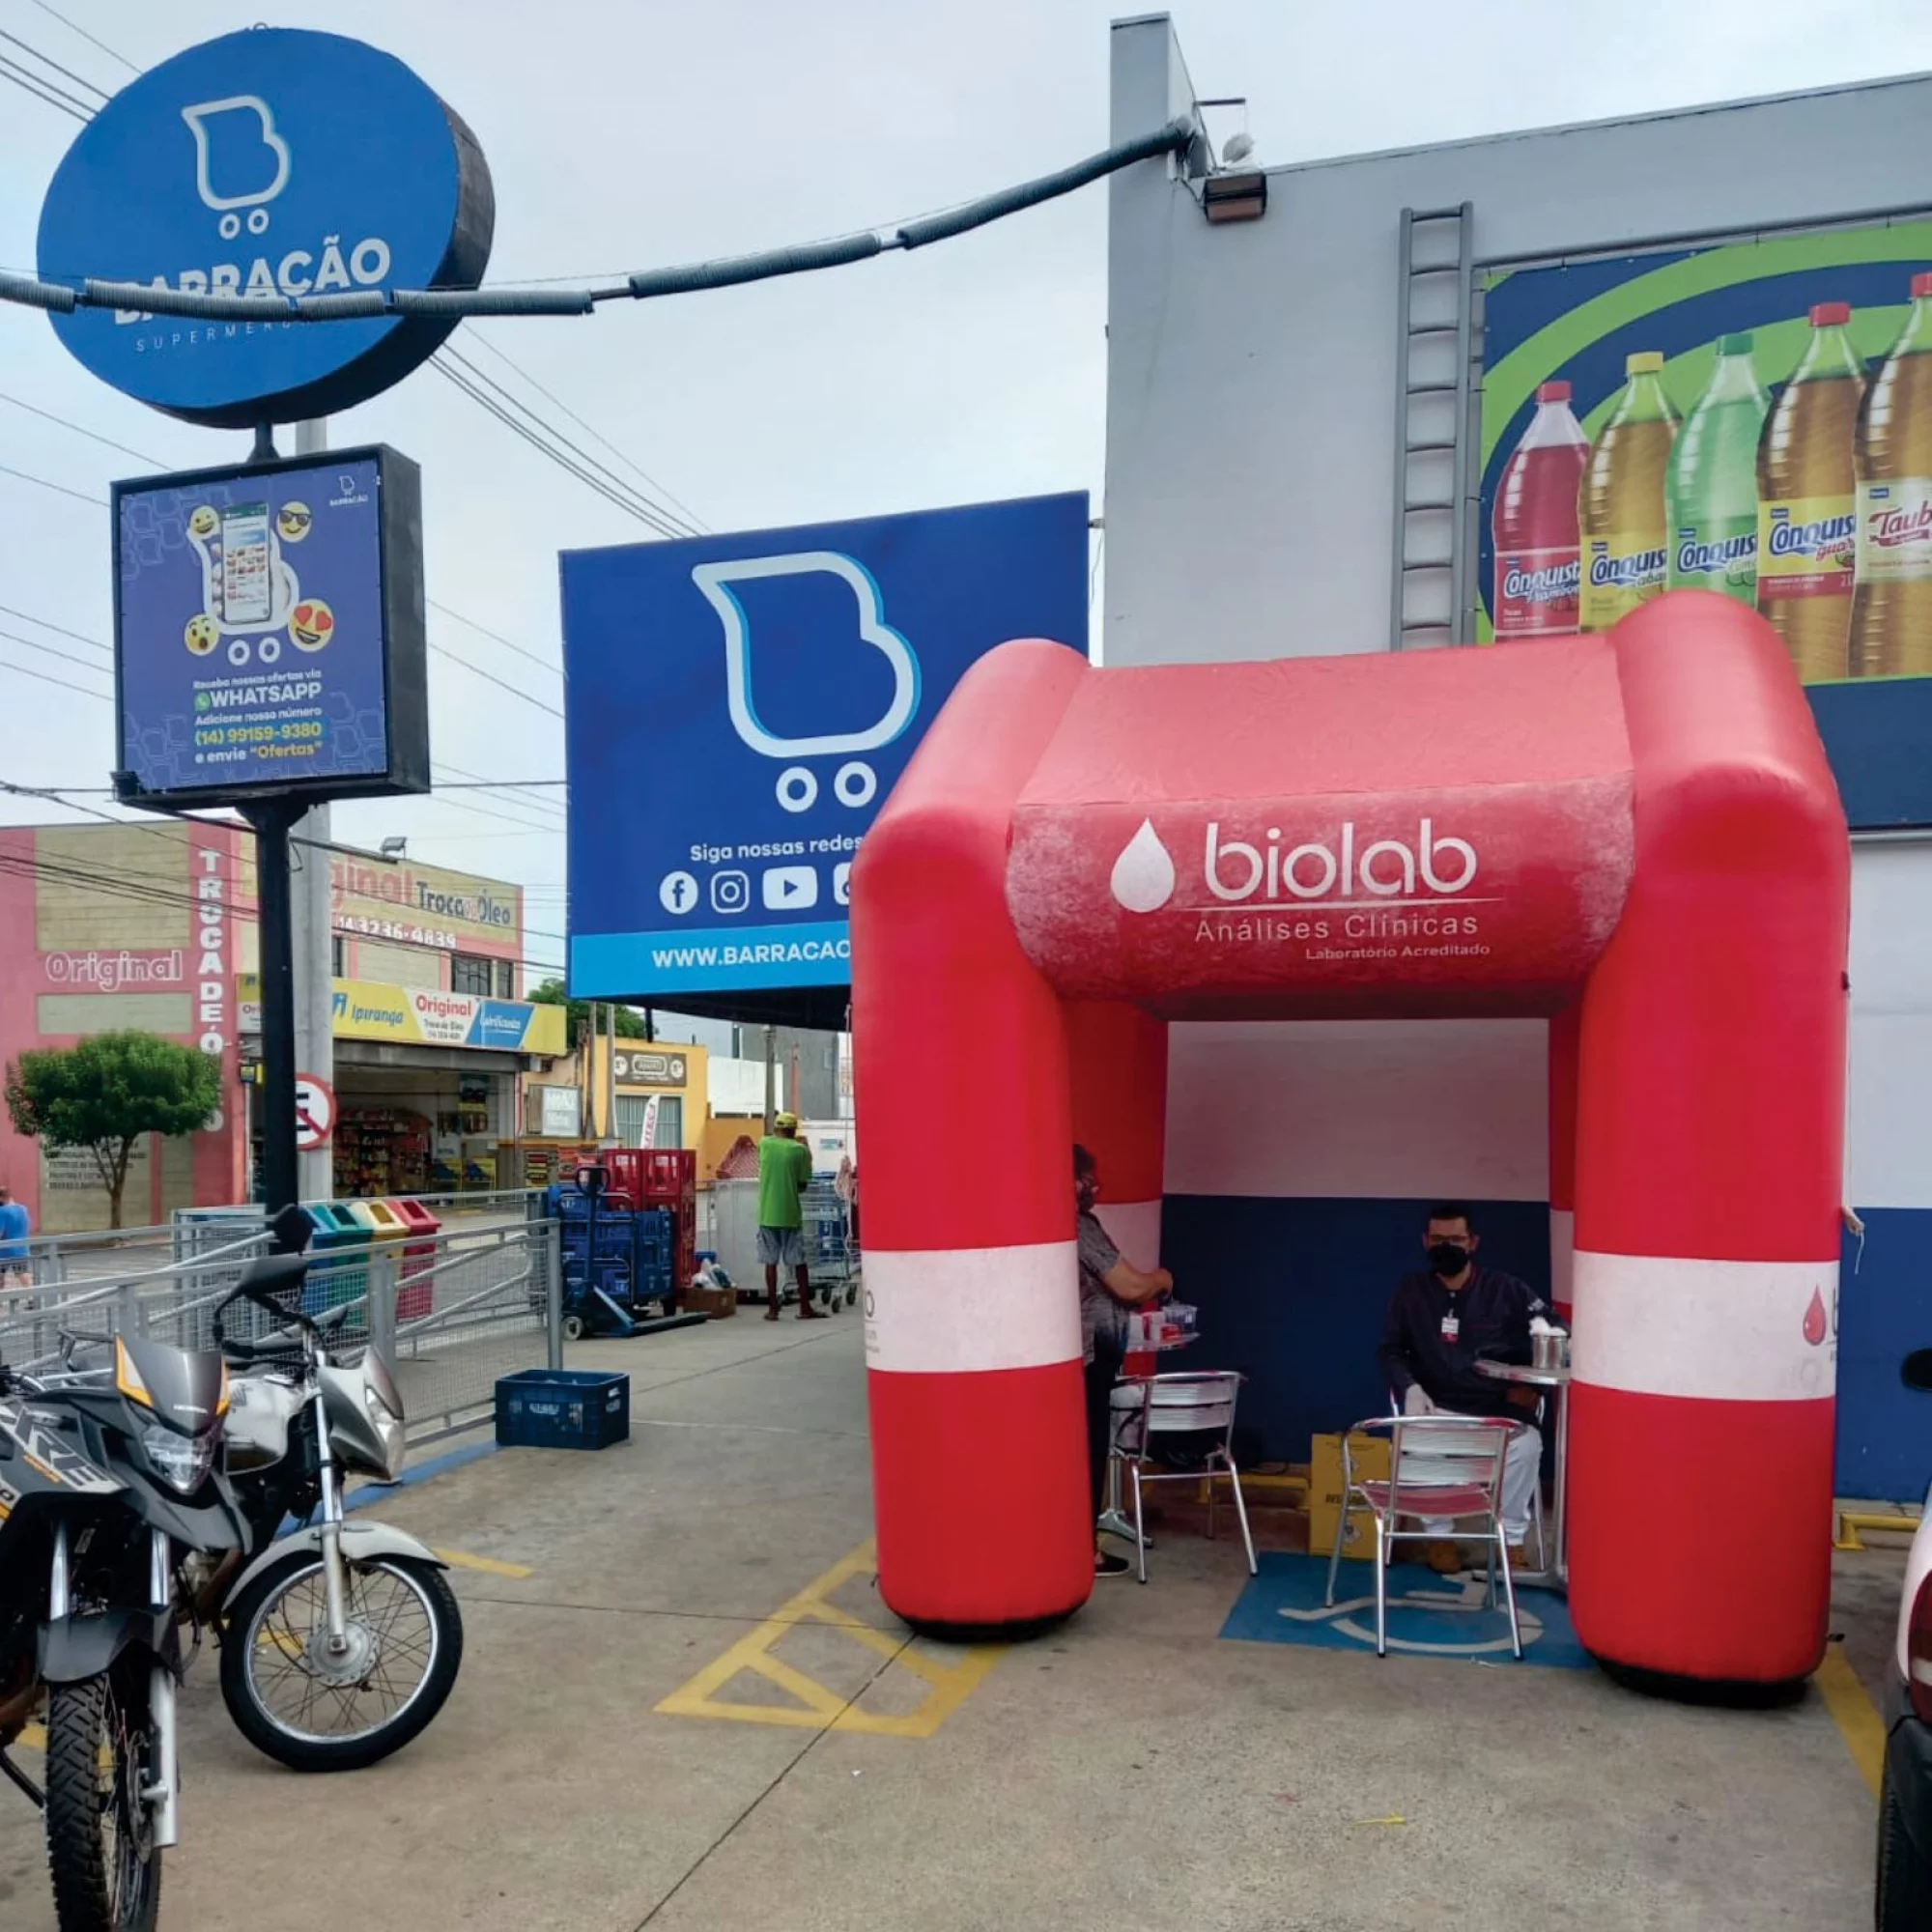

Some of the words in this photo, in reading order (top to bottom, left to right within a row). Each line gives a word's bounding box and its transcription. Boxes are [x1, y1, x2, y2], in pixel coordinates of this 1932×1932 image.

[1503, 561, 1580, 599] Conquist
[304, 668, 322, 679] via
[210, 682, 322, 707] WHATSAPP
[244, 711, 276, 722] nosso
[195, 727, 224, 746] (14)
[195, 753, 204, 764] e
[207, 747, 246, 763] envie
[690, 843, 733, 864] Siga
[737, 840, 805, 859] nossas
[809, 834, 864, 853] redes
[1205, 818, 1477, 901] biolab
[416, 881, 464, 917] Troca
[1194, 919, 1330, 943] Análises
[1345, 913, 1479, 937] Clínicas
[1305, 946, 1398, 960] Laboratório
[1402, 944, 1491, 957] Acreditado
[45, 951, 184, 992] Original
[352, 1004, 404, 1027] Ipiranga
[415, 995, 472, 1017] Original
